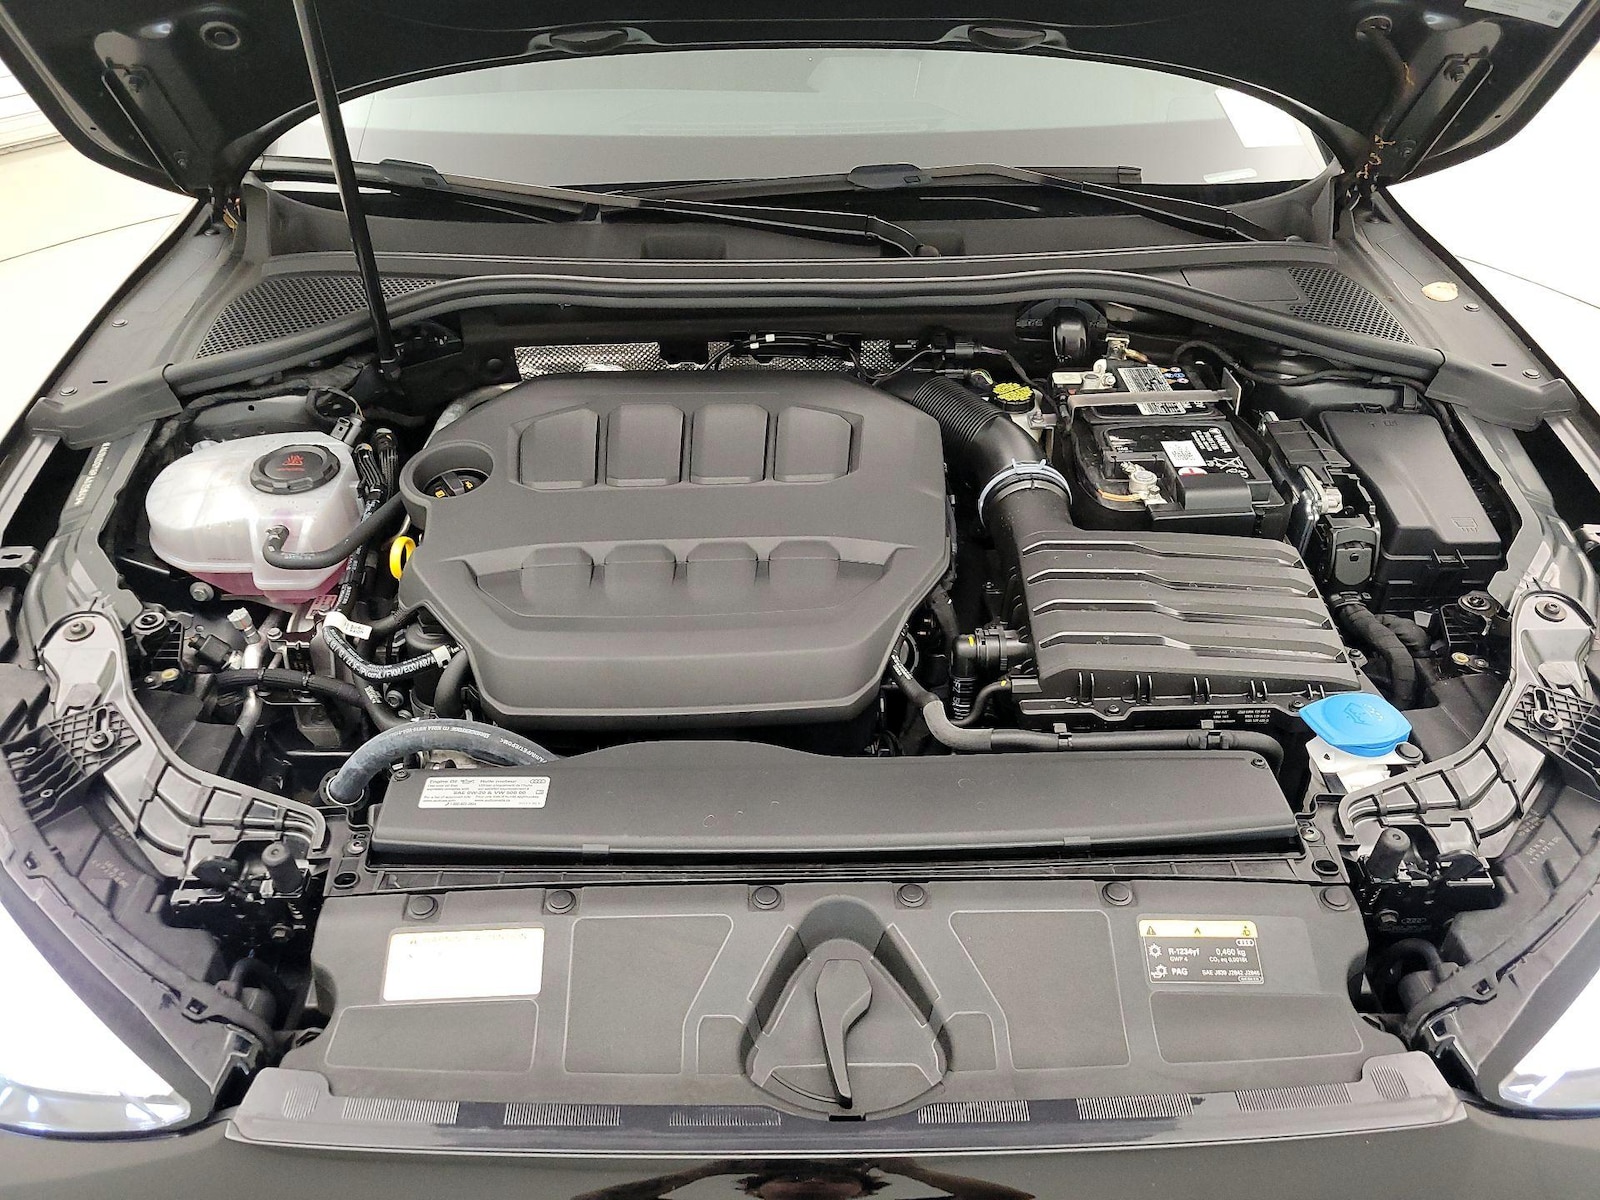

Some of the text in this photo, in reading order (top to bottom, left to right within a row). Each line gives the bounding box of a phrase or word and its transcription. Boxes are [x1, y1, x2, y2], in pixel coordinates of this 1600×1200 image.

[1168, 948, 1200, 957] R-1234yf
[1237, 948, 1246, 957] kg
[1171, 967, 1188, 976] PAG
